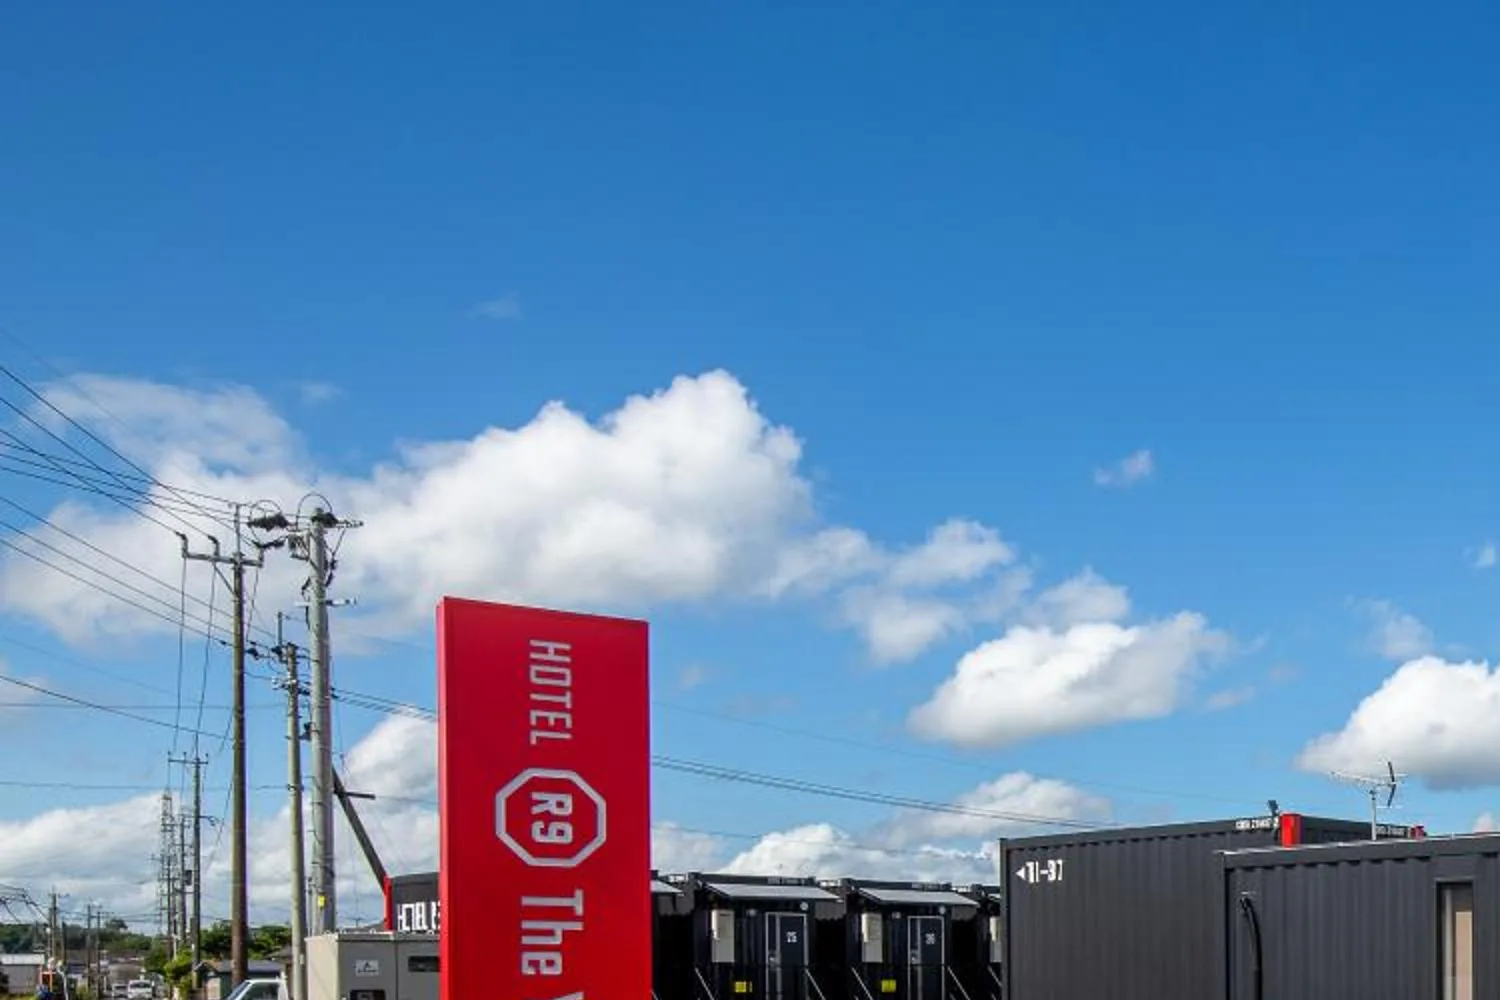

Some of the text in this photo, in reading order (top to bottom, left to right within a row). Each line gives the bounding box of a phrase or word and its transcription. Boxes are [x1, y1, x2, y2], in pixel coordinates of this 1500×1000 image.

[529, 639, 572, 745] HOTEL
[531, 792, 573, 844] R9
[521, 889, 584, 975] The
